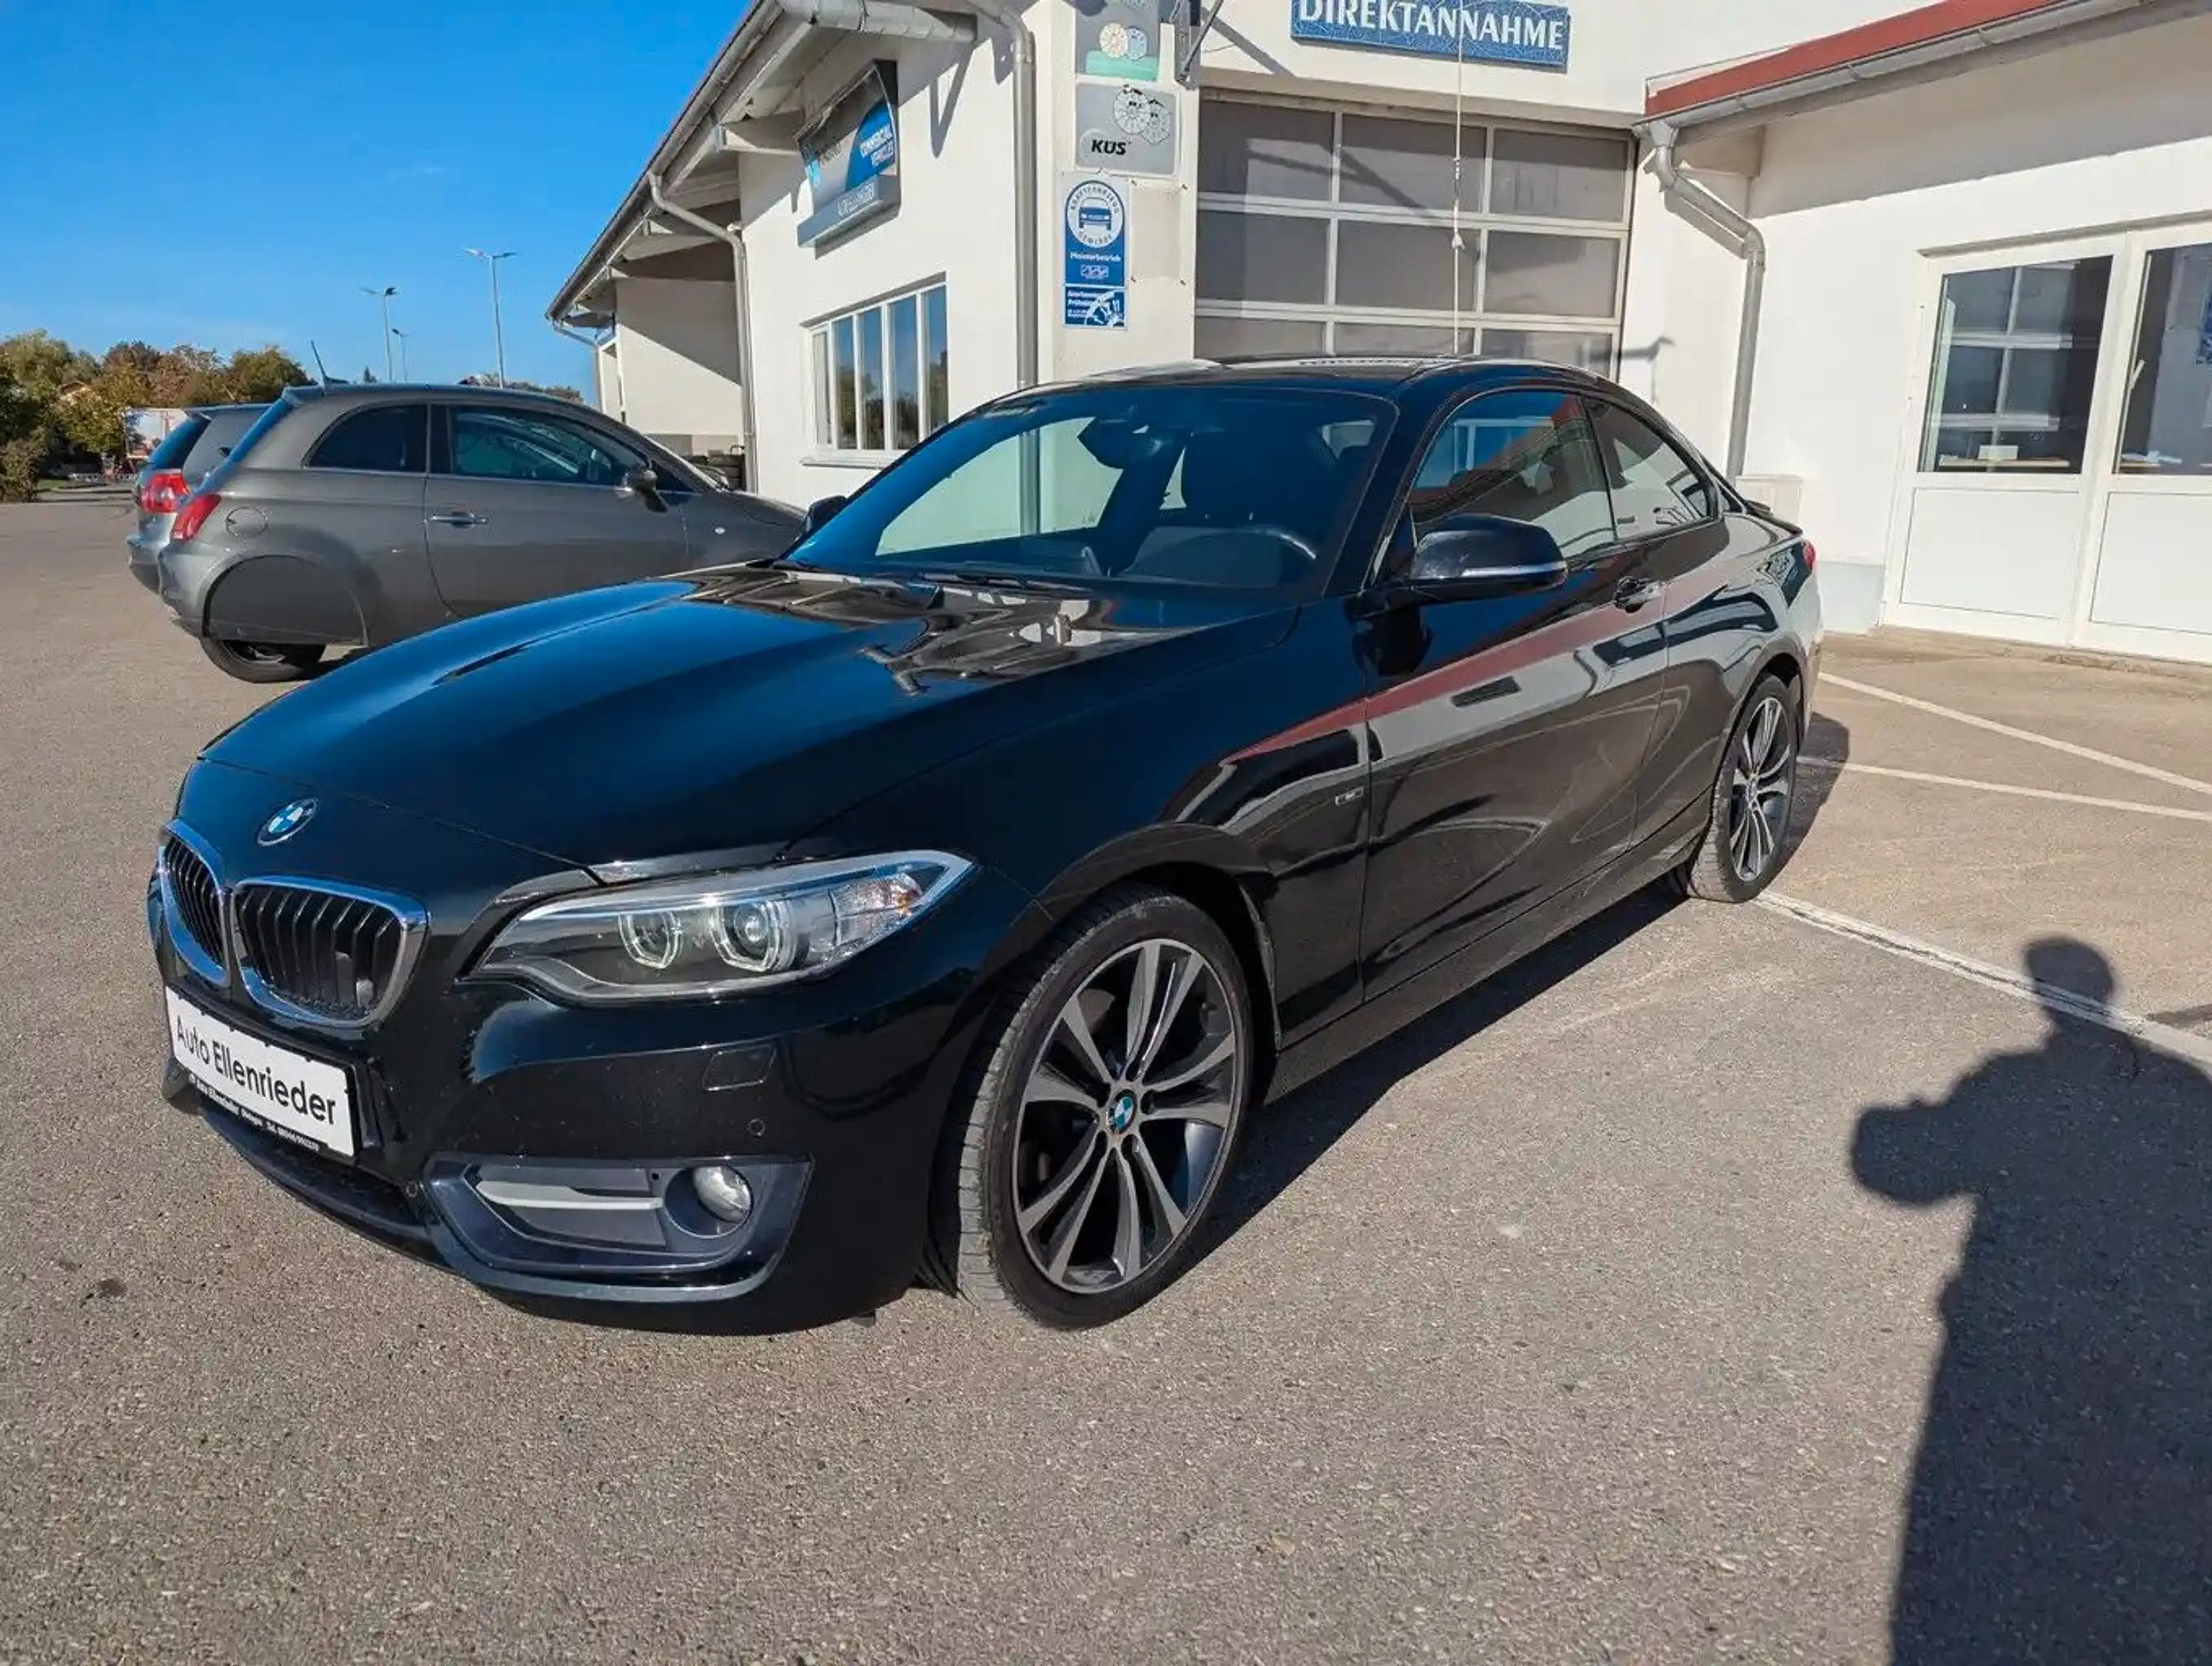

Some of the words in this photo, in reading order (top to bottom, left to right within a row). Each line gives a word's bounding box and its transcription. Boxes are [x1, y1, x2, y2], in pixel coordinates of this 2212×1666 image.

[1299, 0, 1563, 50] DIREKTANNAHME
[176, 1015, 210, 1065] Auto
[212, 1041, 336, 1125] Ellenrieder
